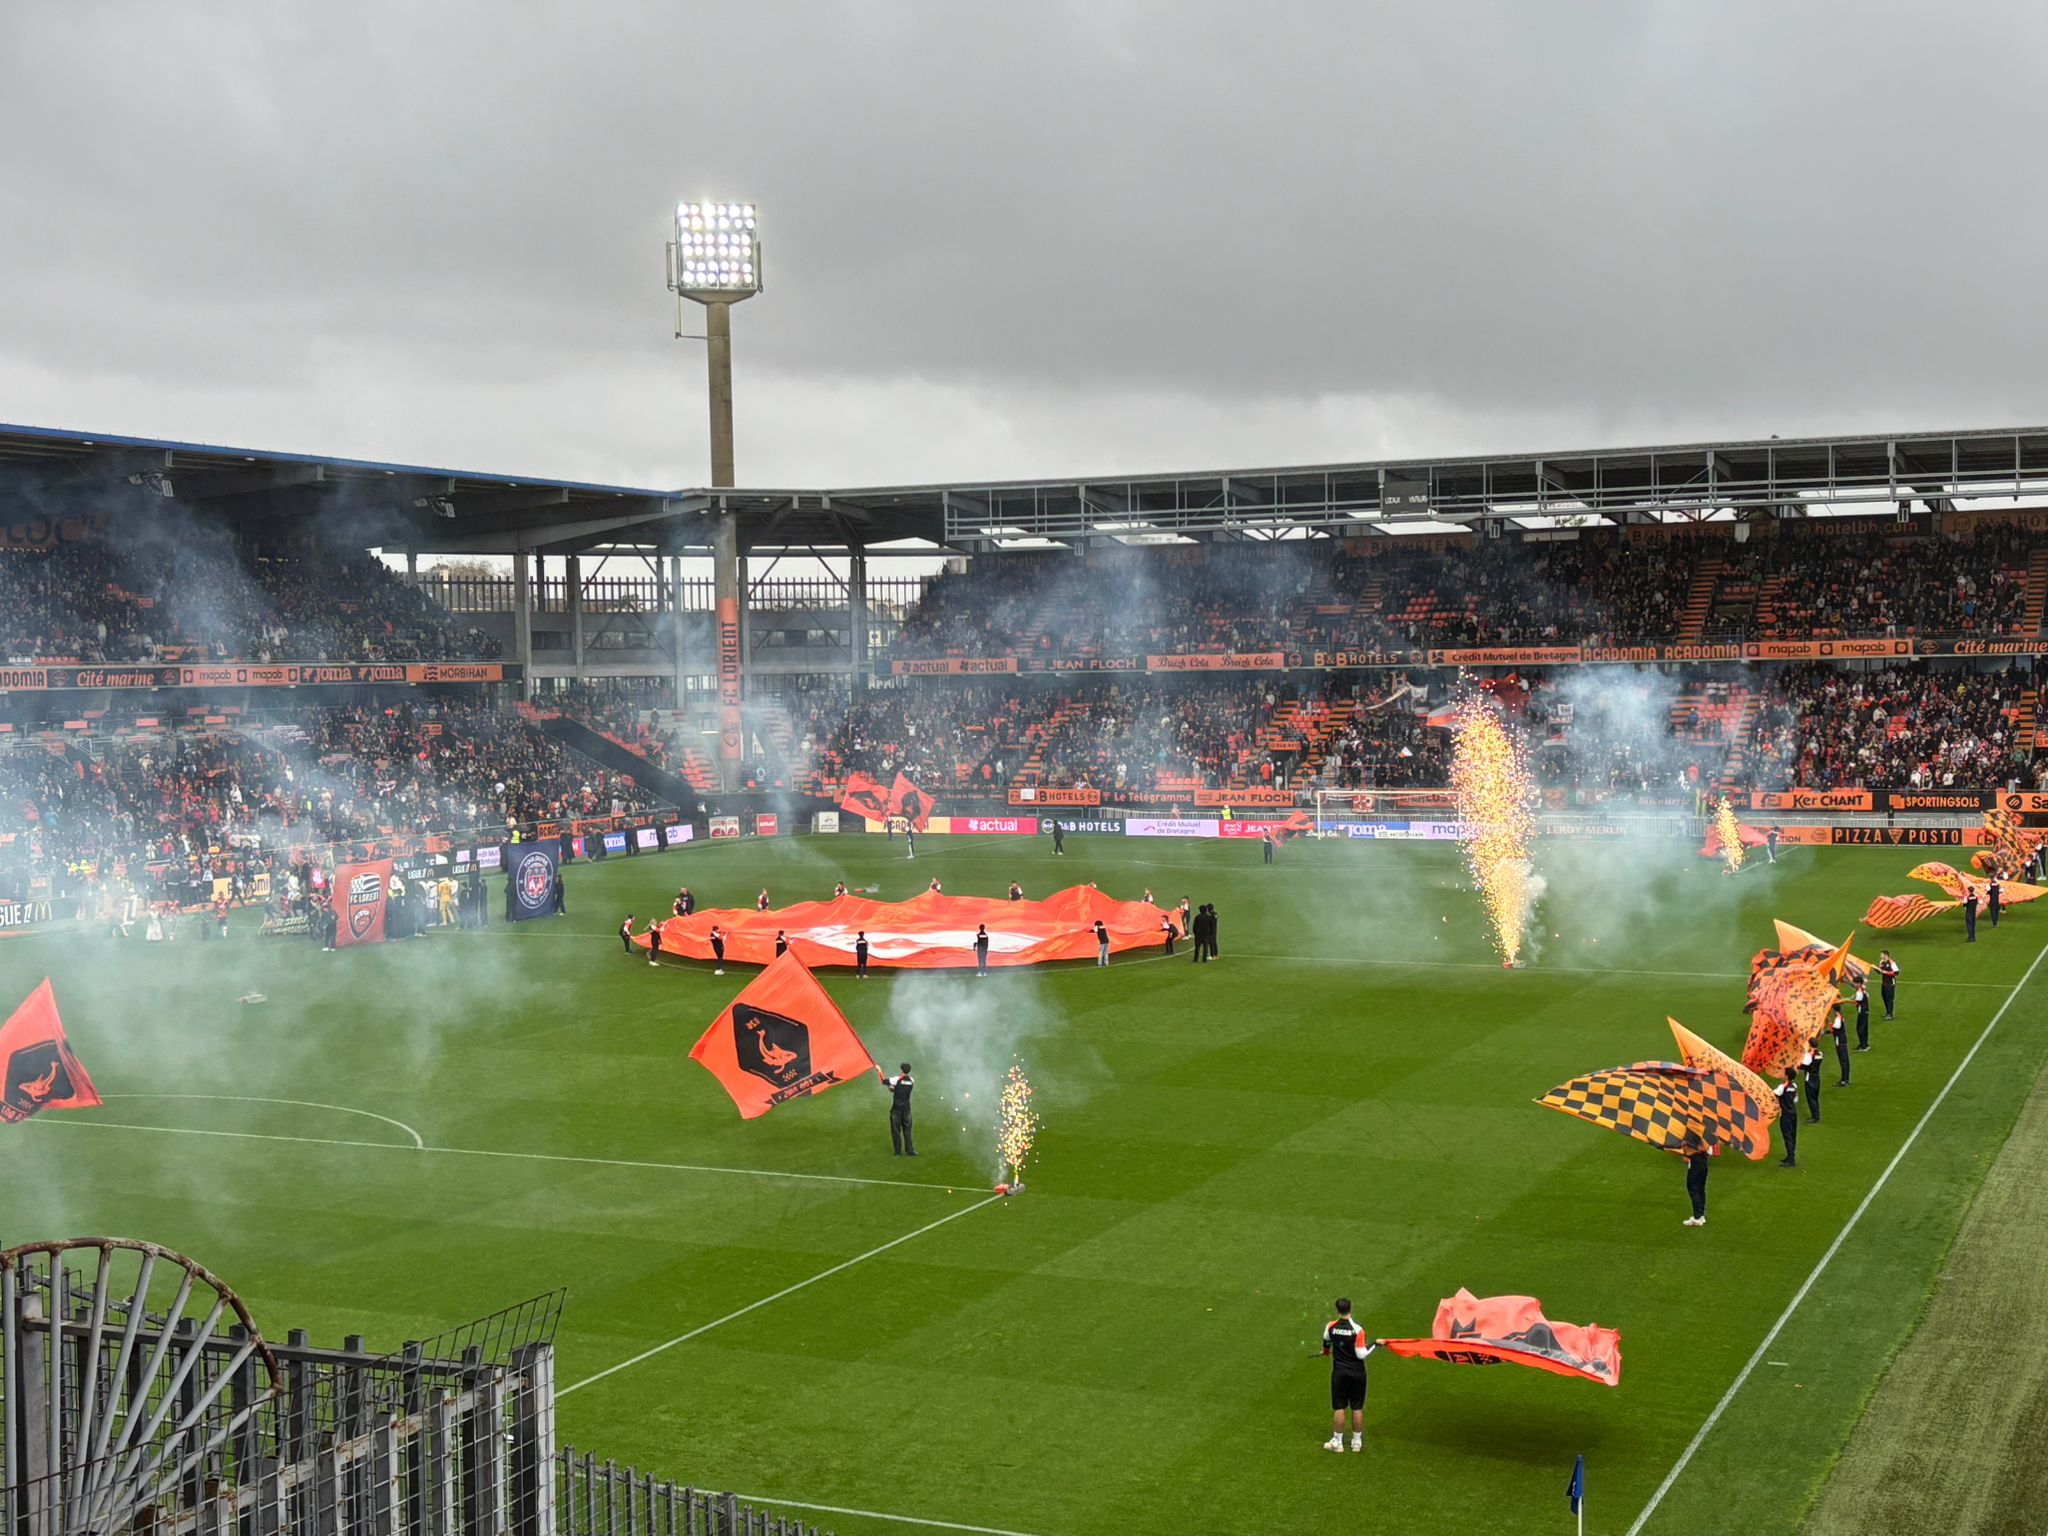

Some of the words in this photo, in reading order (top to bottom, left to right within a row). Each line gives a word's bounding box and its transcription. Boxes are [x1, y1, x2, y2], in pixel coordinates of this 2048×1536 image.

[721, 620, 737, 683] LORIENT
[1664, 644, 1740, 660] ACADOMIA
[1768, 641, 1811, 655] mapab
[1841, 639, 1886, 654] mapab
[1954, 639, 1987, 654] Cité
[1314, 652, 1347, 667] B&B
[1349, 653, 1398, 664] HOTELS
[1452, 652, 1481, 662] Crédit
[1483, 651, 1518, 661] Mutuel
[1520, 651, 1532, 661] de
[1534, 650, 1579, 662] Bretagne
[1583, 646, 1657, 661] ACADOMIA
[912, 660, 949, 673] actual
[968, 658, 1008, 671] actual
[1050, 658, 1084, 670] JEAN
[1157, 656, 1187, 669] Breizh
[1190, 656, 1209, 667] Cola
[1220, 654, 1250, 668] Breizh
[1254, 655, 1274, 666] Cola
[77, 670, 103, 687] Cité
[106, 669, 154, 687] marine
[199, 669, 232, 684] mapab
[252, 667, 283, 683] mapab
[439, 667, 488, 679] MORBIHAN
[1113, 791, 1128, 801] Le
[1130, 790, 1192, 804] Télégramme
[1216, 793, 1246, 802] JEAN
[1793, 794, 1816, 807] Ker
[1819, 794, 1864, 806] CHANT
[1905, 795, 1980, 808] SPORTINGSOLS
[979, 819, 1018, 831] actual
[1079, 821, 1120, 832] HOTELS
[1157, 820, 1177, 828] Crédit
[1178, 820, 1200, 828] Mutuel
[1546, 825, 1581, 834] LEROY
[1584, 825, 1626, 835] MERLIN
[1166, 828, 1195, 836] Bretagne
[1835, 829, 1882, 843] PIZZA
[1909, 829, 1959, 843] POSTO
